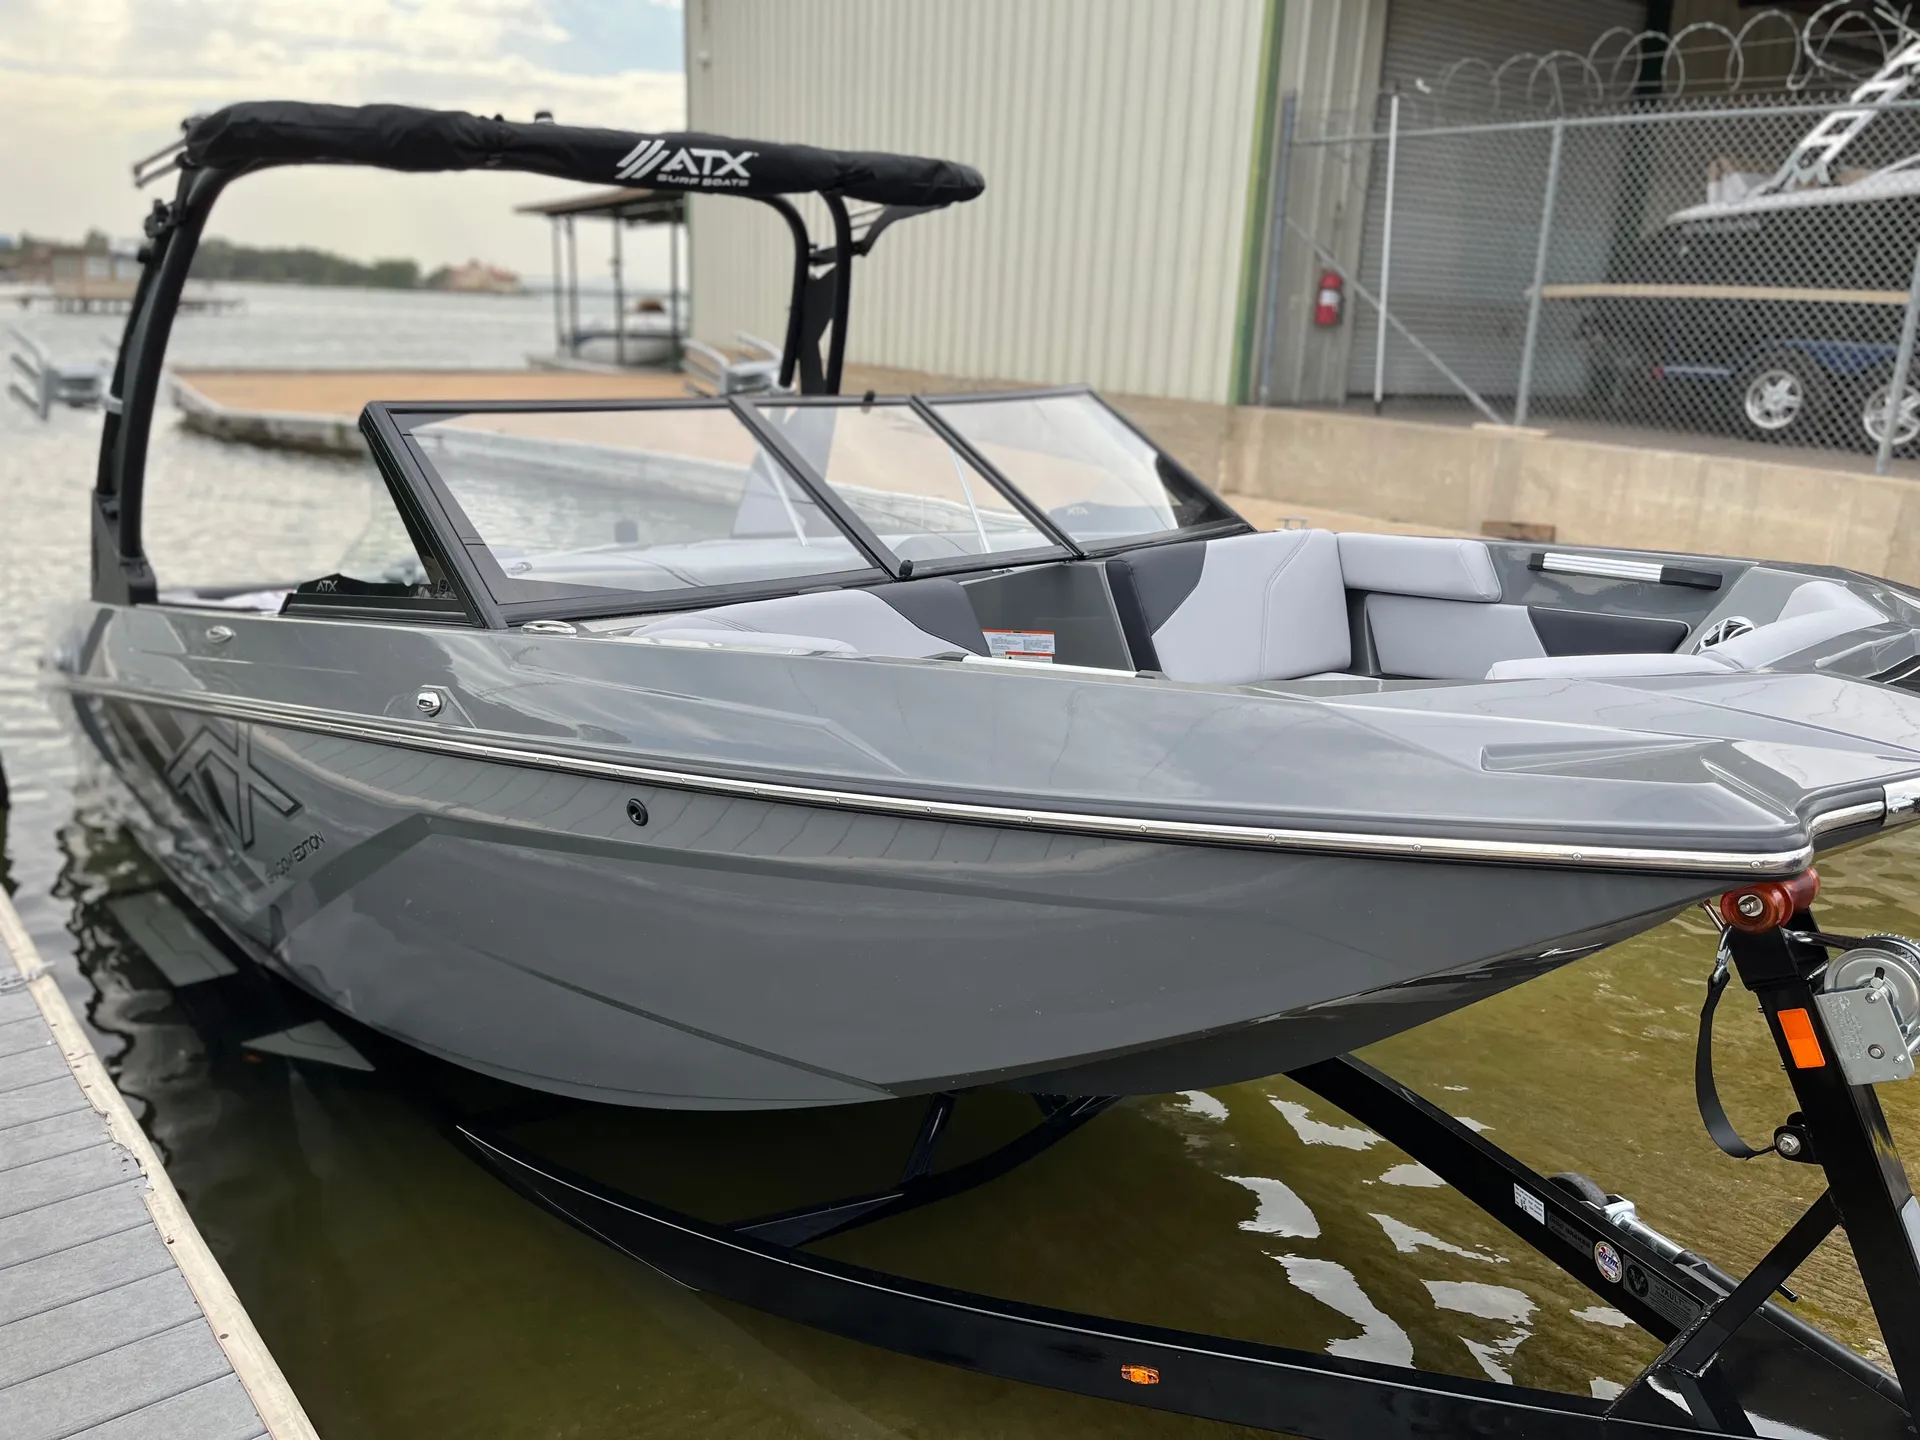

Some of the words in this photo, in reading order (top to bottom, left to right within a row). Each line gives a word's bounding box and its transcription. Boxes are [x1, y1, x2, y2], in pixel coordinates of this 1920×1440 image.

[660, 147, 753, 178] ATX
[656, 174, 699, 185] SURF
[702, 177, 749, 187] BOATS
[316, 580, 338, 593] ATX
